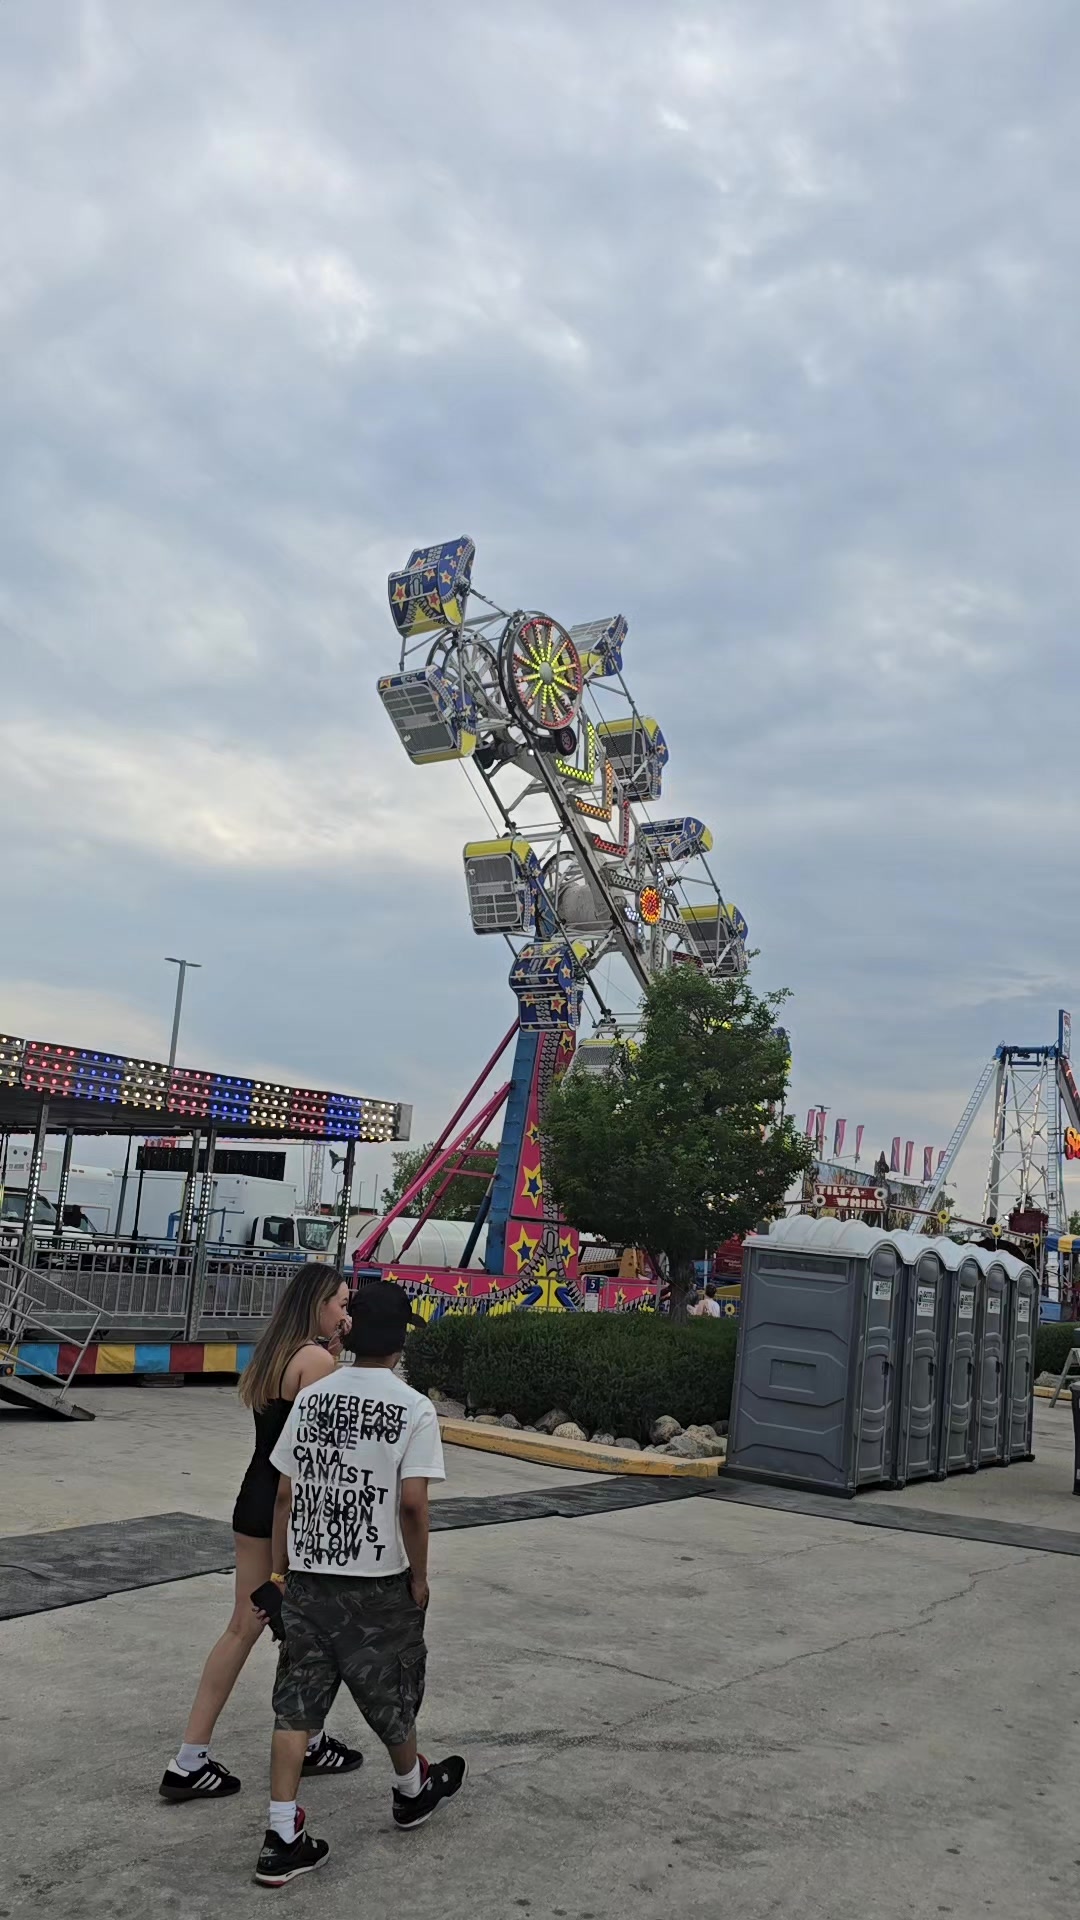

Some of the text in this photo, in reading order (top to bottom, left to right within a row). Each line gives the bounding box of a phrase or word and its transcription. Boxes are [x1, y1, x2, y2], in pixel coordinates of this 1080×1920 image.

[836, 1198, 883, 1209] WHIRL
[590, 1279, 596, 1289] 5
[298, 1393, 360, 1411] LOWER
[361, 1399, 408, 1421] EAST
[293, 1445, 347, 1466] CANAL
